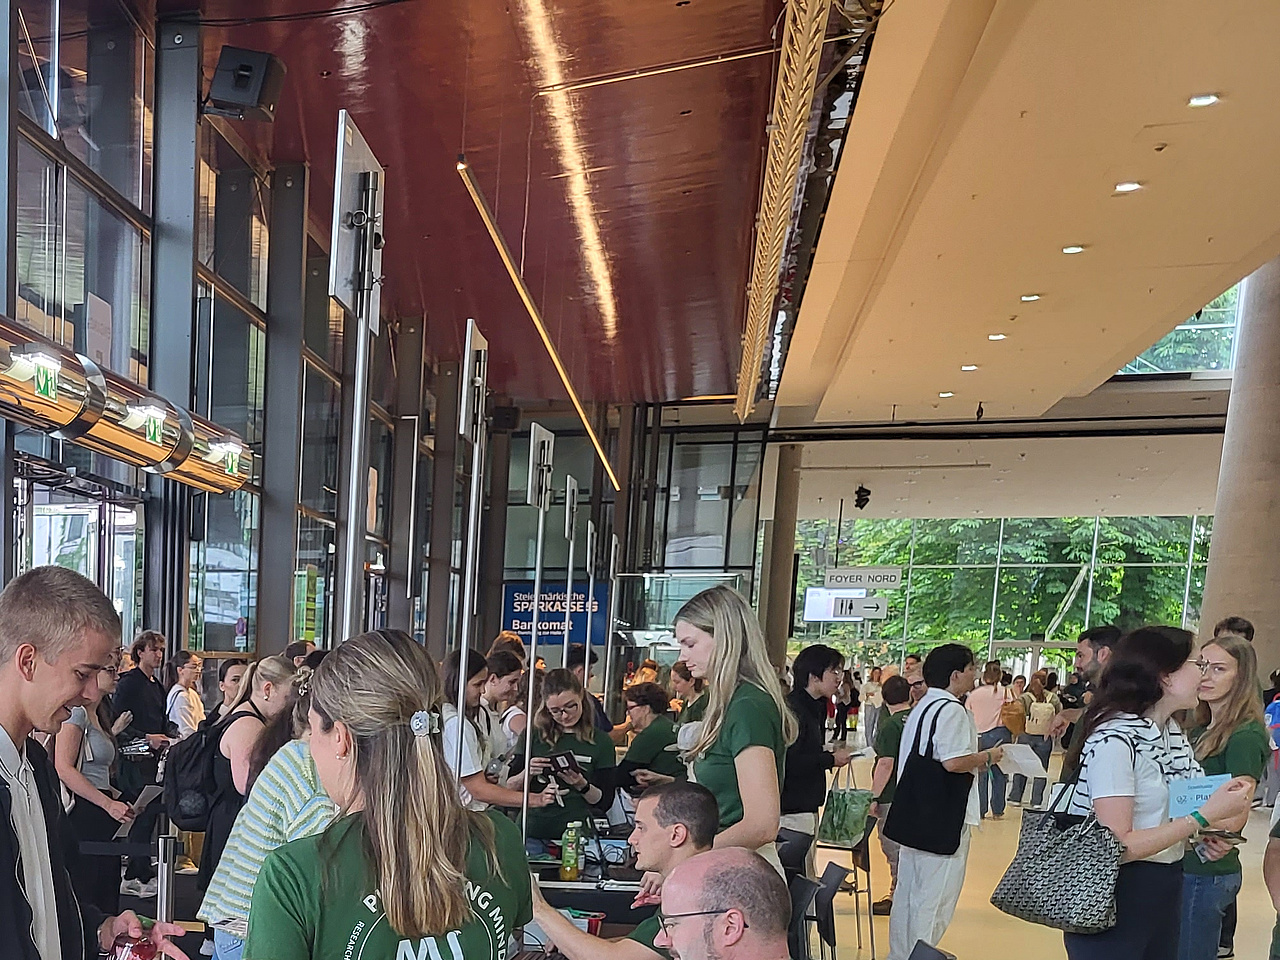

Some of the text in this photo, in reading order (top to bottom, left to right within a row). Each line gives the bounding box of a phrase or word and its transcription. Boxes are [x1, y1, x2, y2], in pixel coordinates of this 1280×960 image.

[829, 574, 897, 583] FOYER NORD
[513, 592, 585, 600] Steiemärkishe
[513, 602, 585, 612] SPARKASSE
[343, 921, 365, 960] RESEARCH
